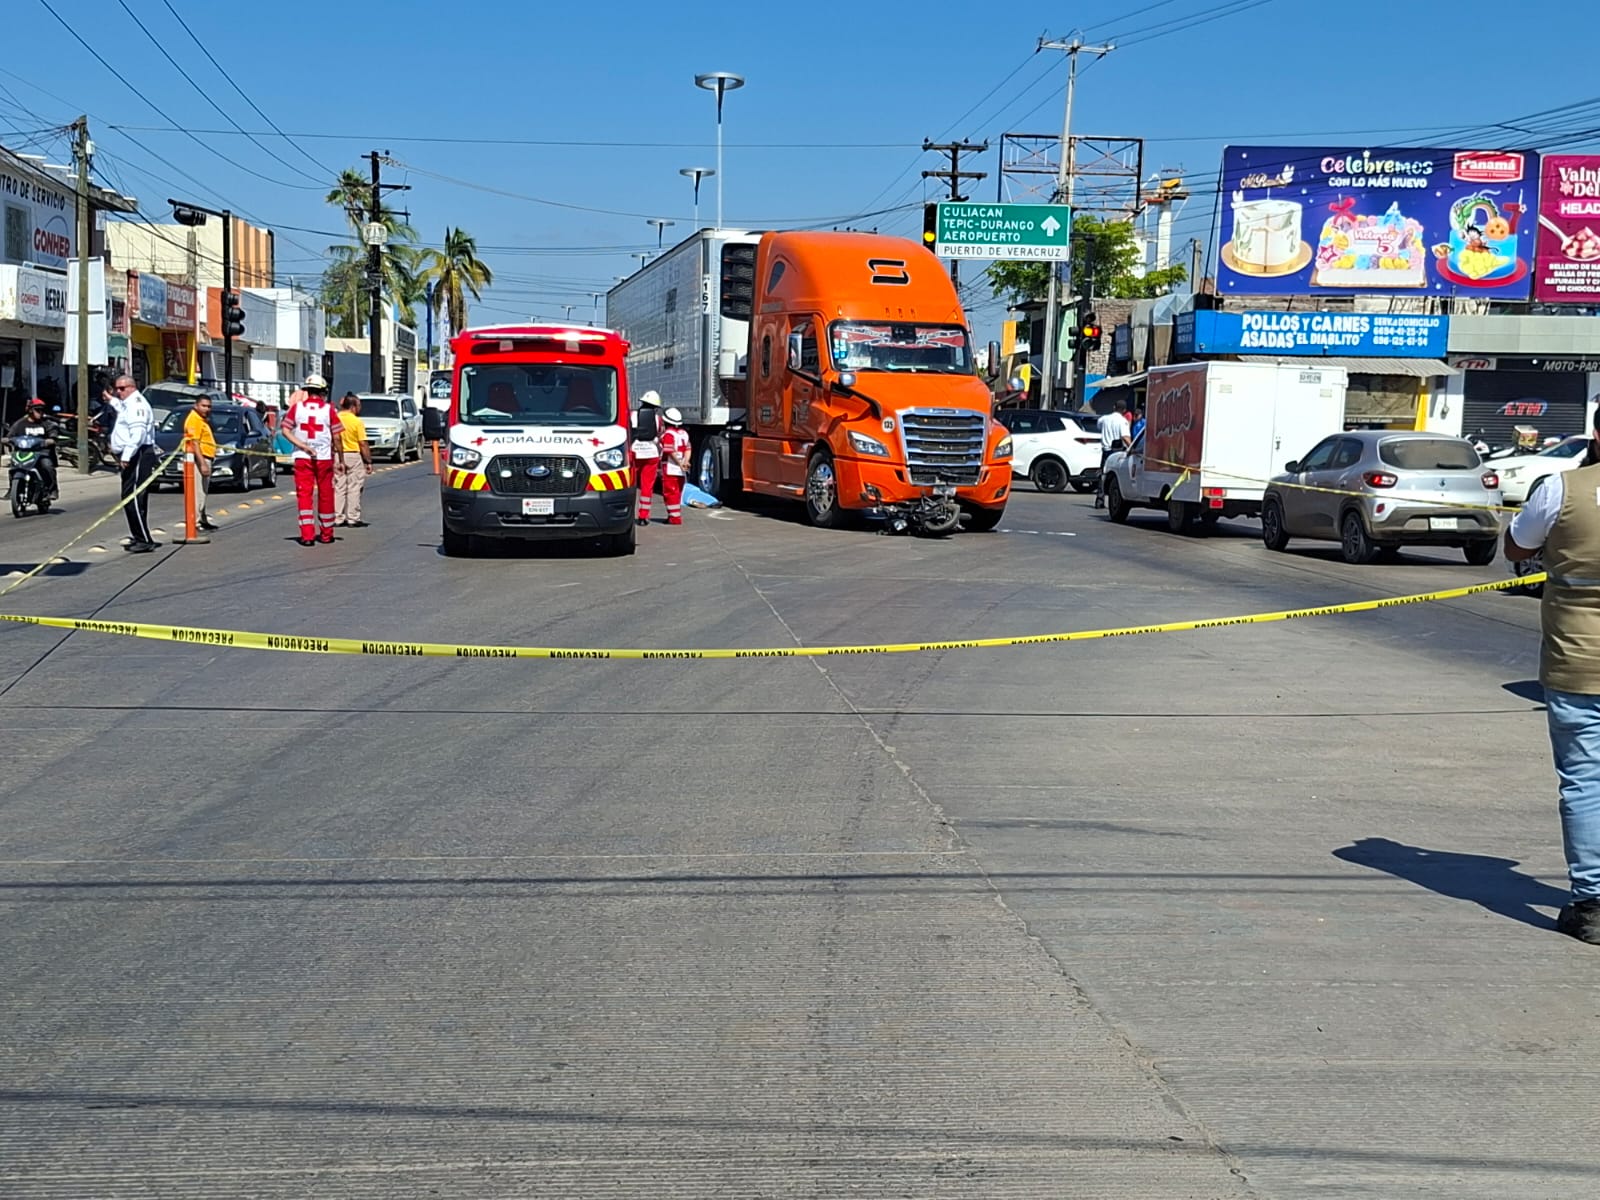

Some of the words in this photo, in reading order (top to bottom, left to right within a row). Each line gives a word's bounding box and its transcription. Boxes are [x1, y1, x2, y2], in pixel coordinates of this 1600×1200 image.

[1320, 155, 1433, 175] Celebremos
[1461, 159, 1516, 170] Panamá
[1328, 177, 1350, 187] CON
[1352, 177, 1366, 187] LO
[1367, 174, 1391, 187] MÁS
[1392, 178, 1428, 188] NUEVO
[20, 181, 30, 199] DE
[32, 184, 65, 211] SERVICIO
[943, 207, 1003, 218] CULIACAN
[943, 218, 1034, 231] TEPIC-DURANGO
[34, 228, 71, 258] GONHER
[943, 231, 1021, 242] AEROPUERTO
[944, 246, 983, 255] PUERTO
[989, 246, 1001, 256] DE
[1007, 247, 1061, 257] VERACRUZ
[1377, 240, 1393, 255] 5
[45, 287, 67, 312] HERRA
[1242, 314, 1299, 331] POLLOS
[1302, 318, 1311, 331] Y
[1311, 315, 1370, 333] CARNES
[1240, 331, 1295, 349] ASADAS
[172, 629, 234, 645] PRECAUCION
[267, 637, 329, 651] PRECAUCION
[362, 643, 423, 656] PRECAUCION
